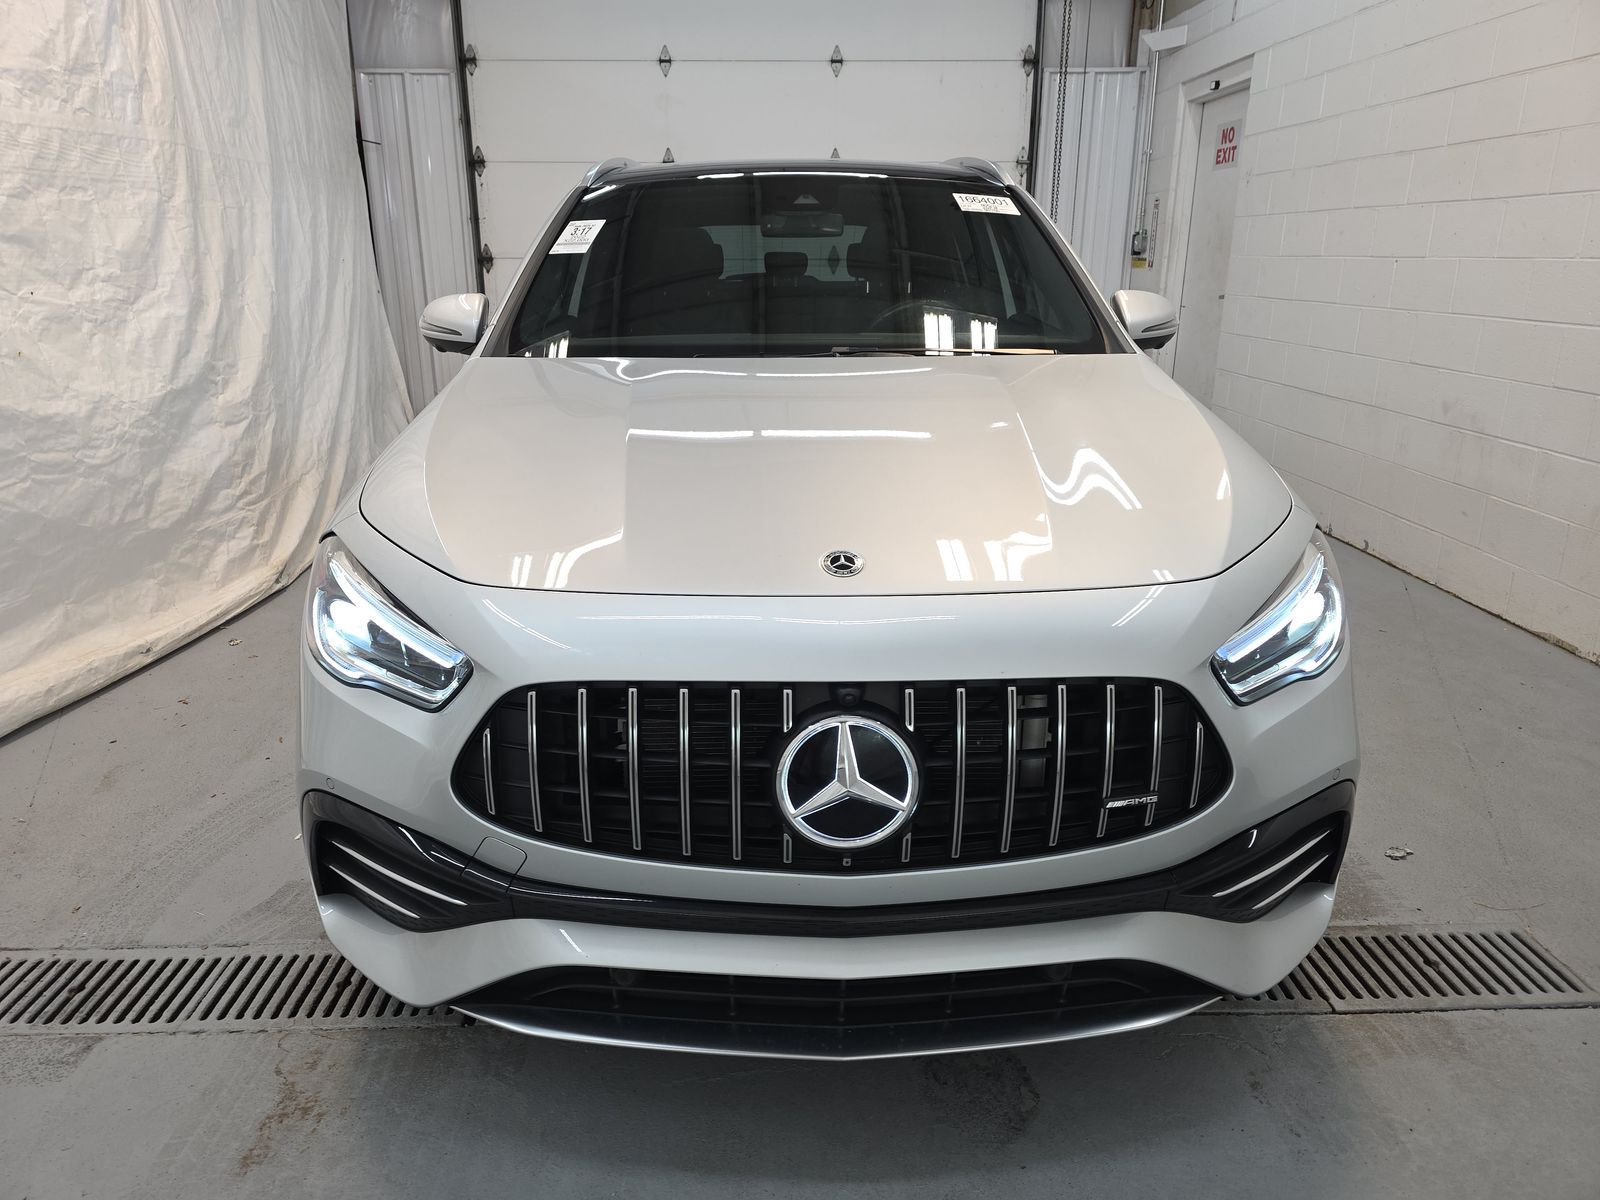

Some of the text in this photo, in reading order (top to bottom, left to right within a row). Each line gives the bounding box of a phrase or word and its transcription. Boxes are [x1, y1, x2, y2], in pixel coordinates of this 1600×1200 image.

[1221, 126, 1235, 145] NO
[1216, 145, 1237, 165] EXIT
[958, 195, 1009, 206] 1664001
[1120, 796, 1158, 806] AMG
